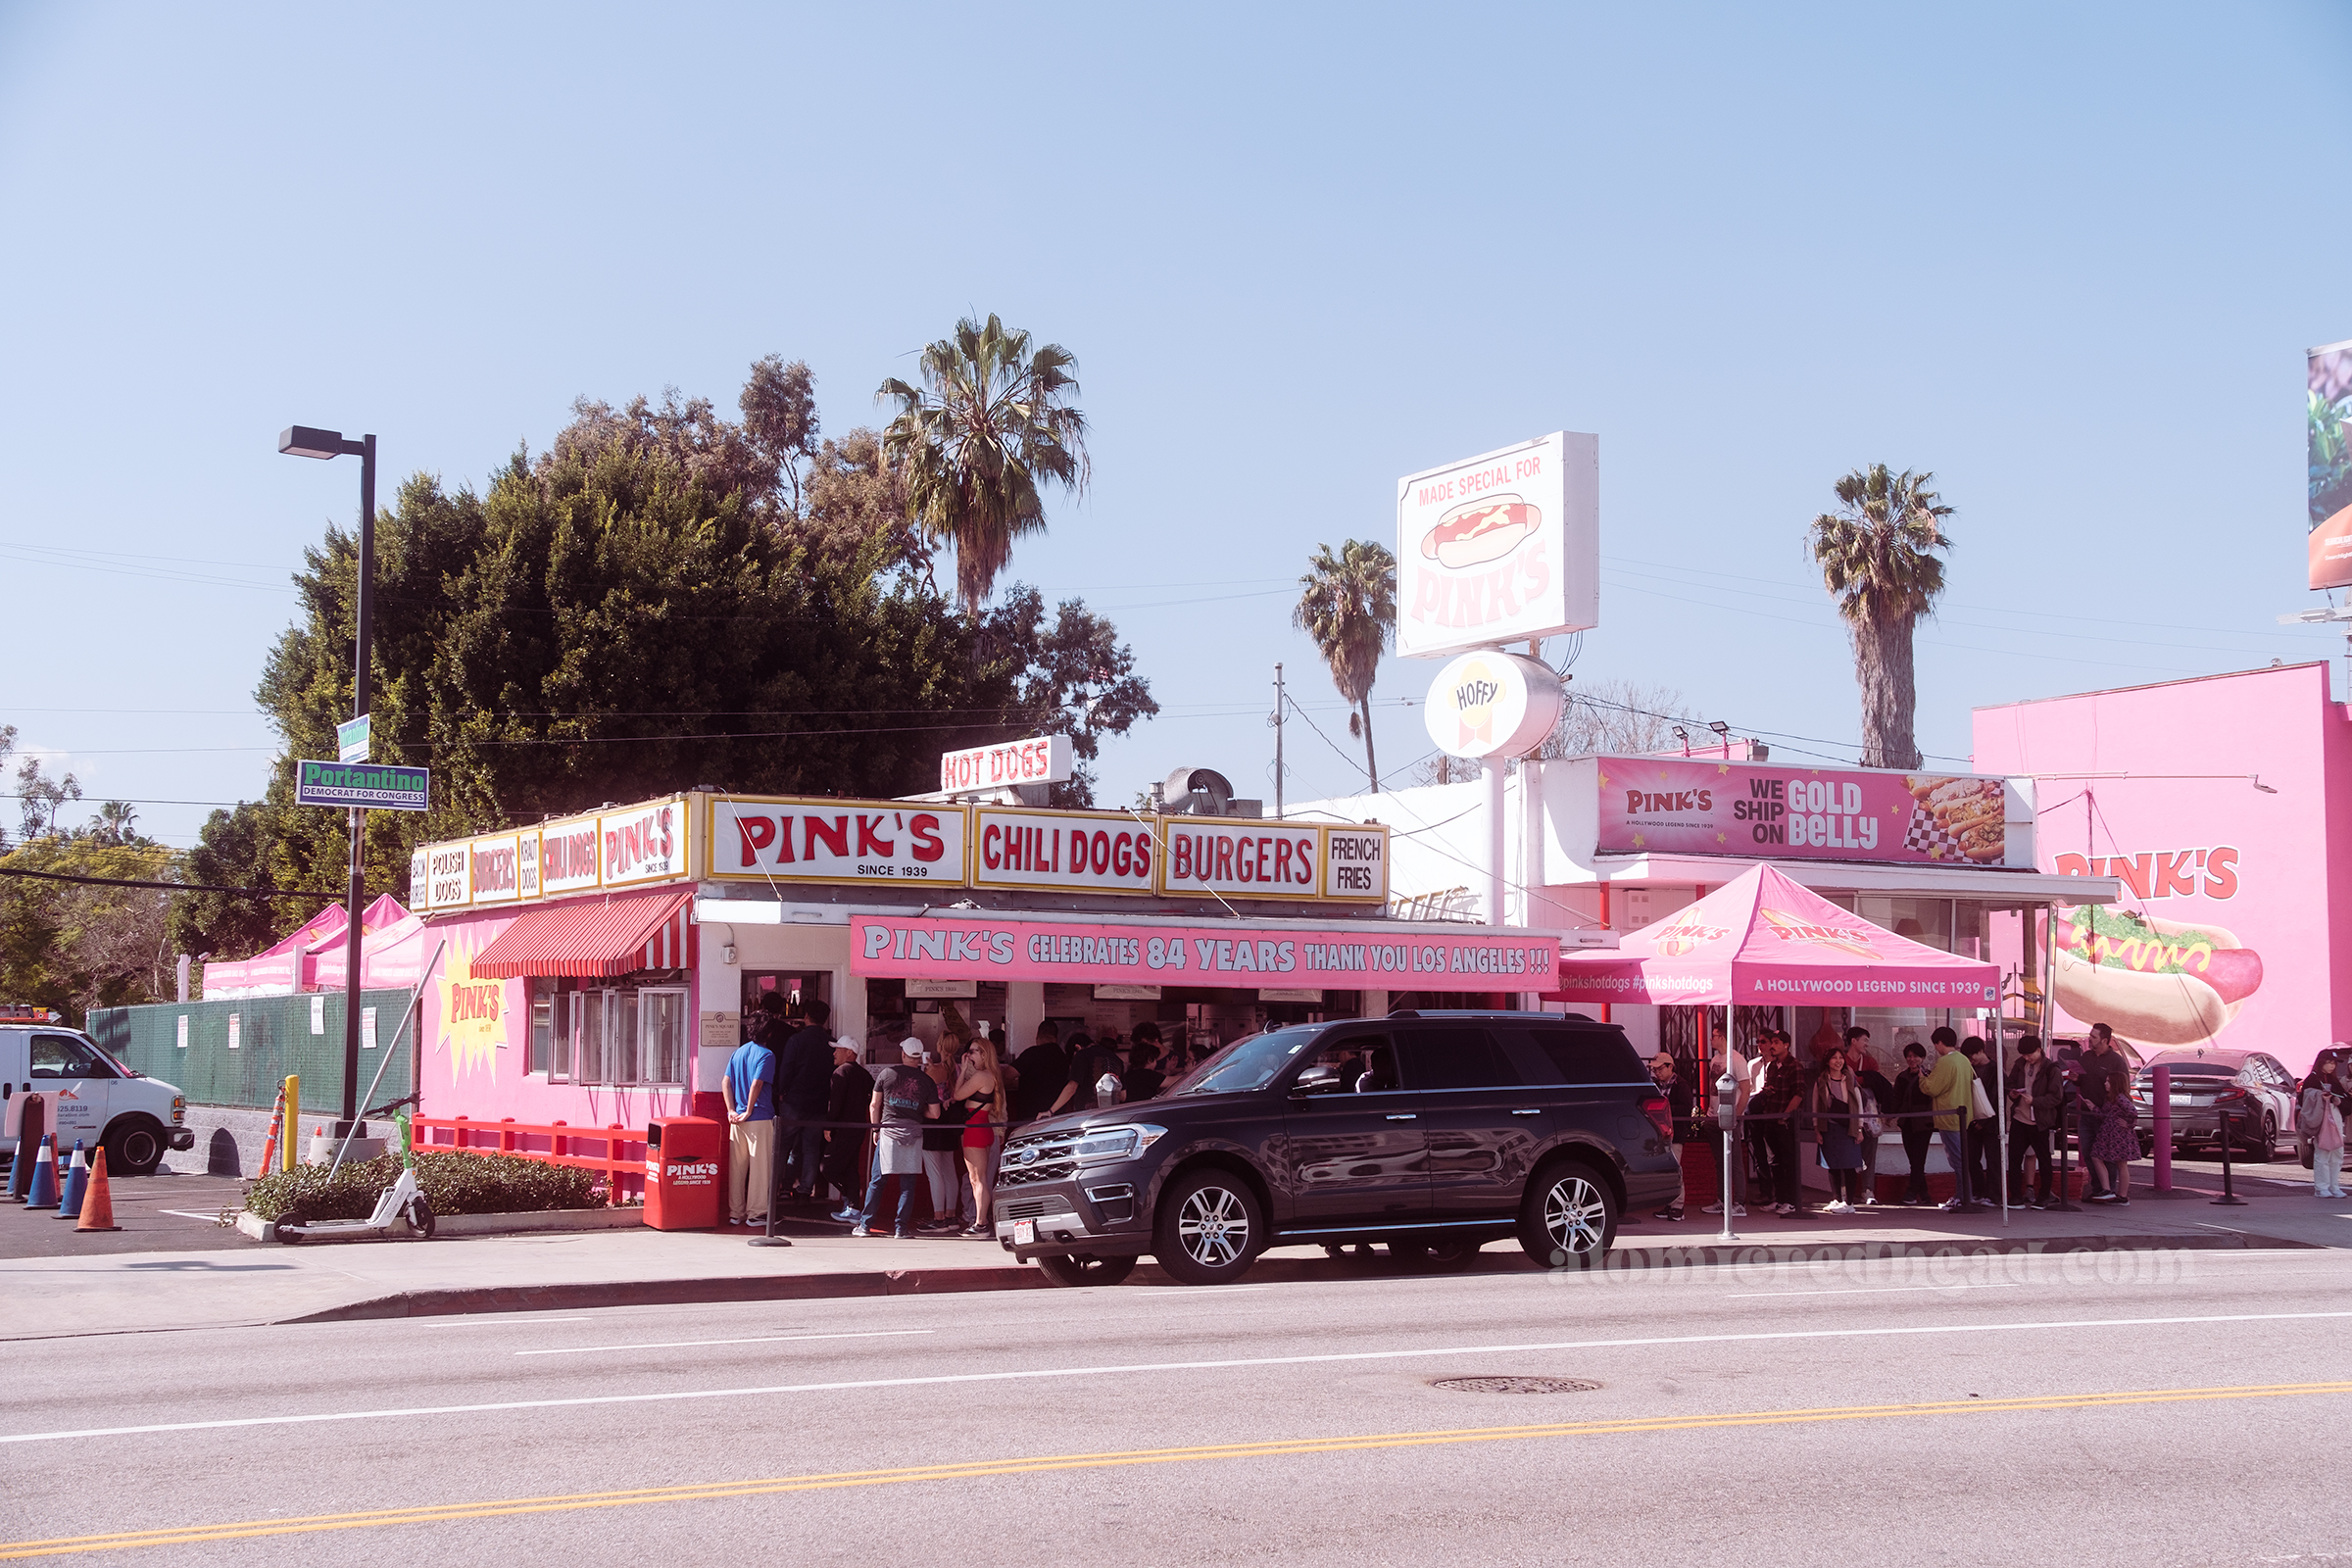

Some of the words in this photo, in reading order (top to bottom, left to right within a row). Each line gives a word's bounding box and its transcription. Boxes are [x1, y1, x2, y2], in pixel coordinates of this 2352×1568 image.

[1419, 481, 1454, 507] MADE
[1459, 466, 1511, 496] SPECIAL
[1516, 457, 1541, 480] FOR
[1410, 539, 1550, 628] PINK'S
[1456, 680, 1498, 710] HOFFY
[304, 763, 424, 791] Portantino
[945, 752, 984, 789] HOT
[991, 741, 1048, 783] DOGS
[304, 787, 355, 798] DEMOCRAT
[357, 790, 374, 799] FOR
[376, 791, 424, 802] CONGRESS
[1626, 788, 1713, 814] PINK'S
[1749, 778, 1784, 800] WE
[1788, 779, 1862, 814] GOLD
[1734, 800, 1785, 821] SHIP
[605, 808, 674, 880] PINK'S
[735, 812, 945, 867] PINK'S
[1752, 822, 1784, 844] ON
[520, 839, 538, 862] KRAUT
[543, 836, 567, 882] CHILI
[568, 831, 596, 878] DOGS
[983, 824, 1060, 872] CHILI
[1069, 830, 1152, 878] DOGS
[1174, 833, 1313, 884] BURGERS
[1332, 837, 1381, 861] FRENCH
[432, 851, 465, 875] POLISH
[473, 847, 515, 893] BURGERS
[858, 864, 895, 876] SINCE
[902, 866, 928, 877] 1939
[521, 866, 538, 889] DOGS
[1337, 866, 1372, 890] FRIES
[435, 878, 462, 902] DOGS
[1651, 924, 1731, 941] PINK'S
[1769, 925, 1871, 942] PINK'S
[862, 924, 1014, 964] PINK'S
[1028, 934, 1140, 965] CELEBRATES
[1147, 937, 1187, 969] 84
[1194, 938, 1297, 972] YEARS
[1303, 943, 1367, 971] THANK
[1370, 945, 1407, 972] YOU
[1412, 946, 1446, 973] LOS
[1450, 947, 1526, 974] ANGELES
[1529, 948, 1550, 975] !!!
[1633, 975, 1713, 994] #pinkshotdogs
[1754, 979, 1763, 991] A
[1767, 980, 1853, 993] HOLLYWOOD
[1857, 981, 1906, 994] LEGEND
[1910, 982, 1945, 994] SINCE
[1950, 982, 1981, 995] 1939
[451, 983, 500, 1023] PINK'S
[666, 1163, 718, 1176] PINK'S
